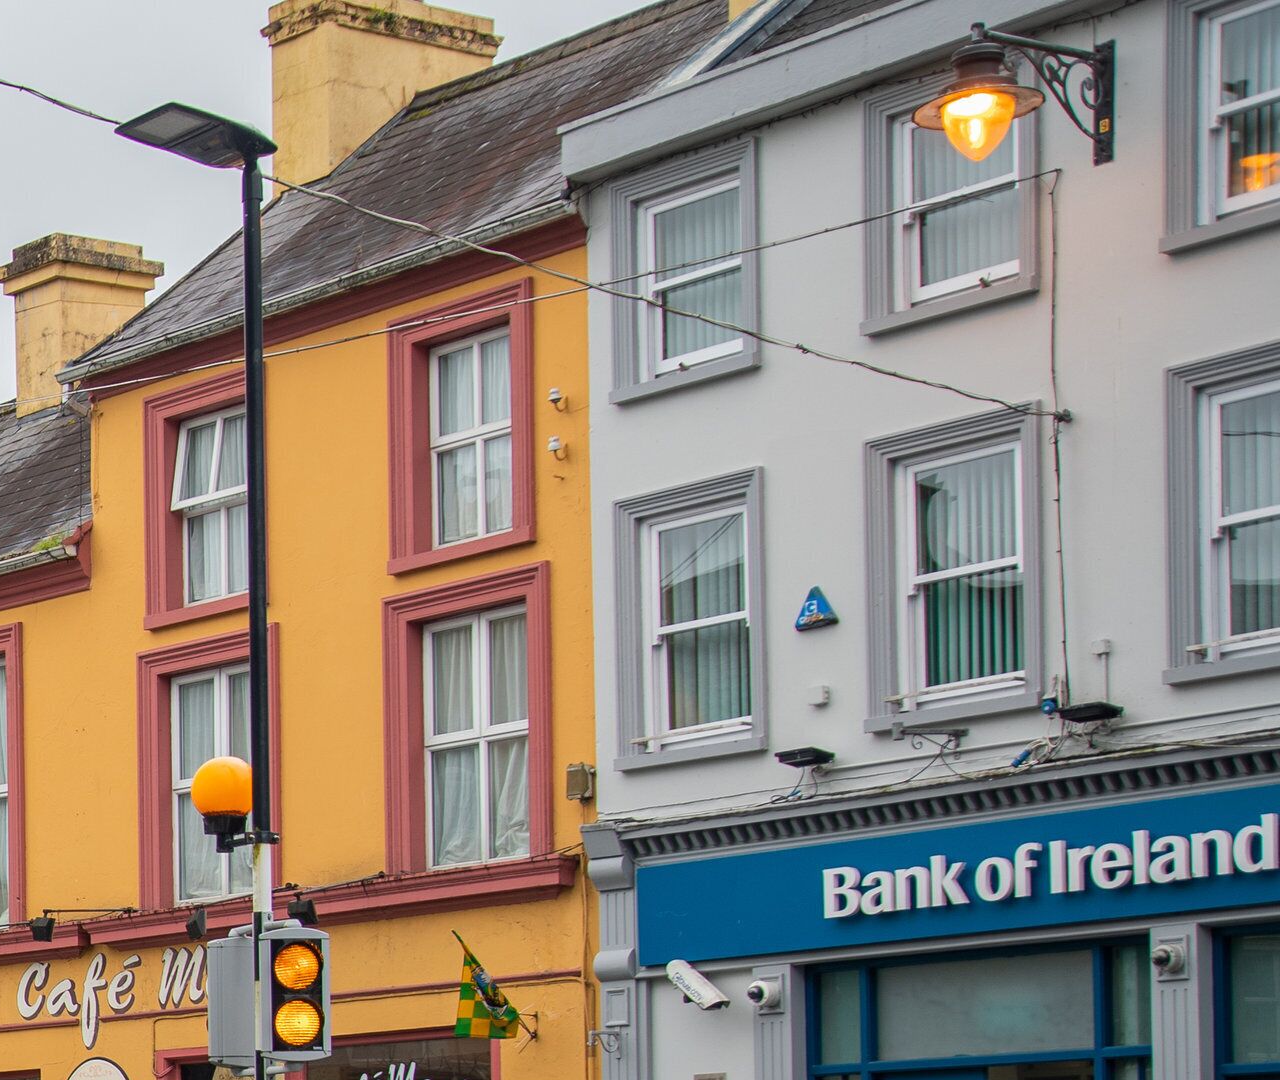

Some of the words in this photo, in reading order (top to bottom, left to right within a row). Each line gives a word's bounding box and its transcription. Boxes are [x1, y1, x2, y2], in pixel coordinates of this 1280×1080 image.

[823, 854, 970, 920] Bank
[975, 841, 1043, 903] of
[1048, 812, 1279, 895] Ireland
[17, 952, 141, 1050] Café
